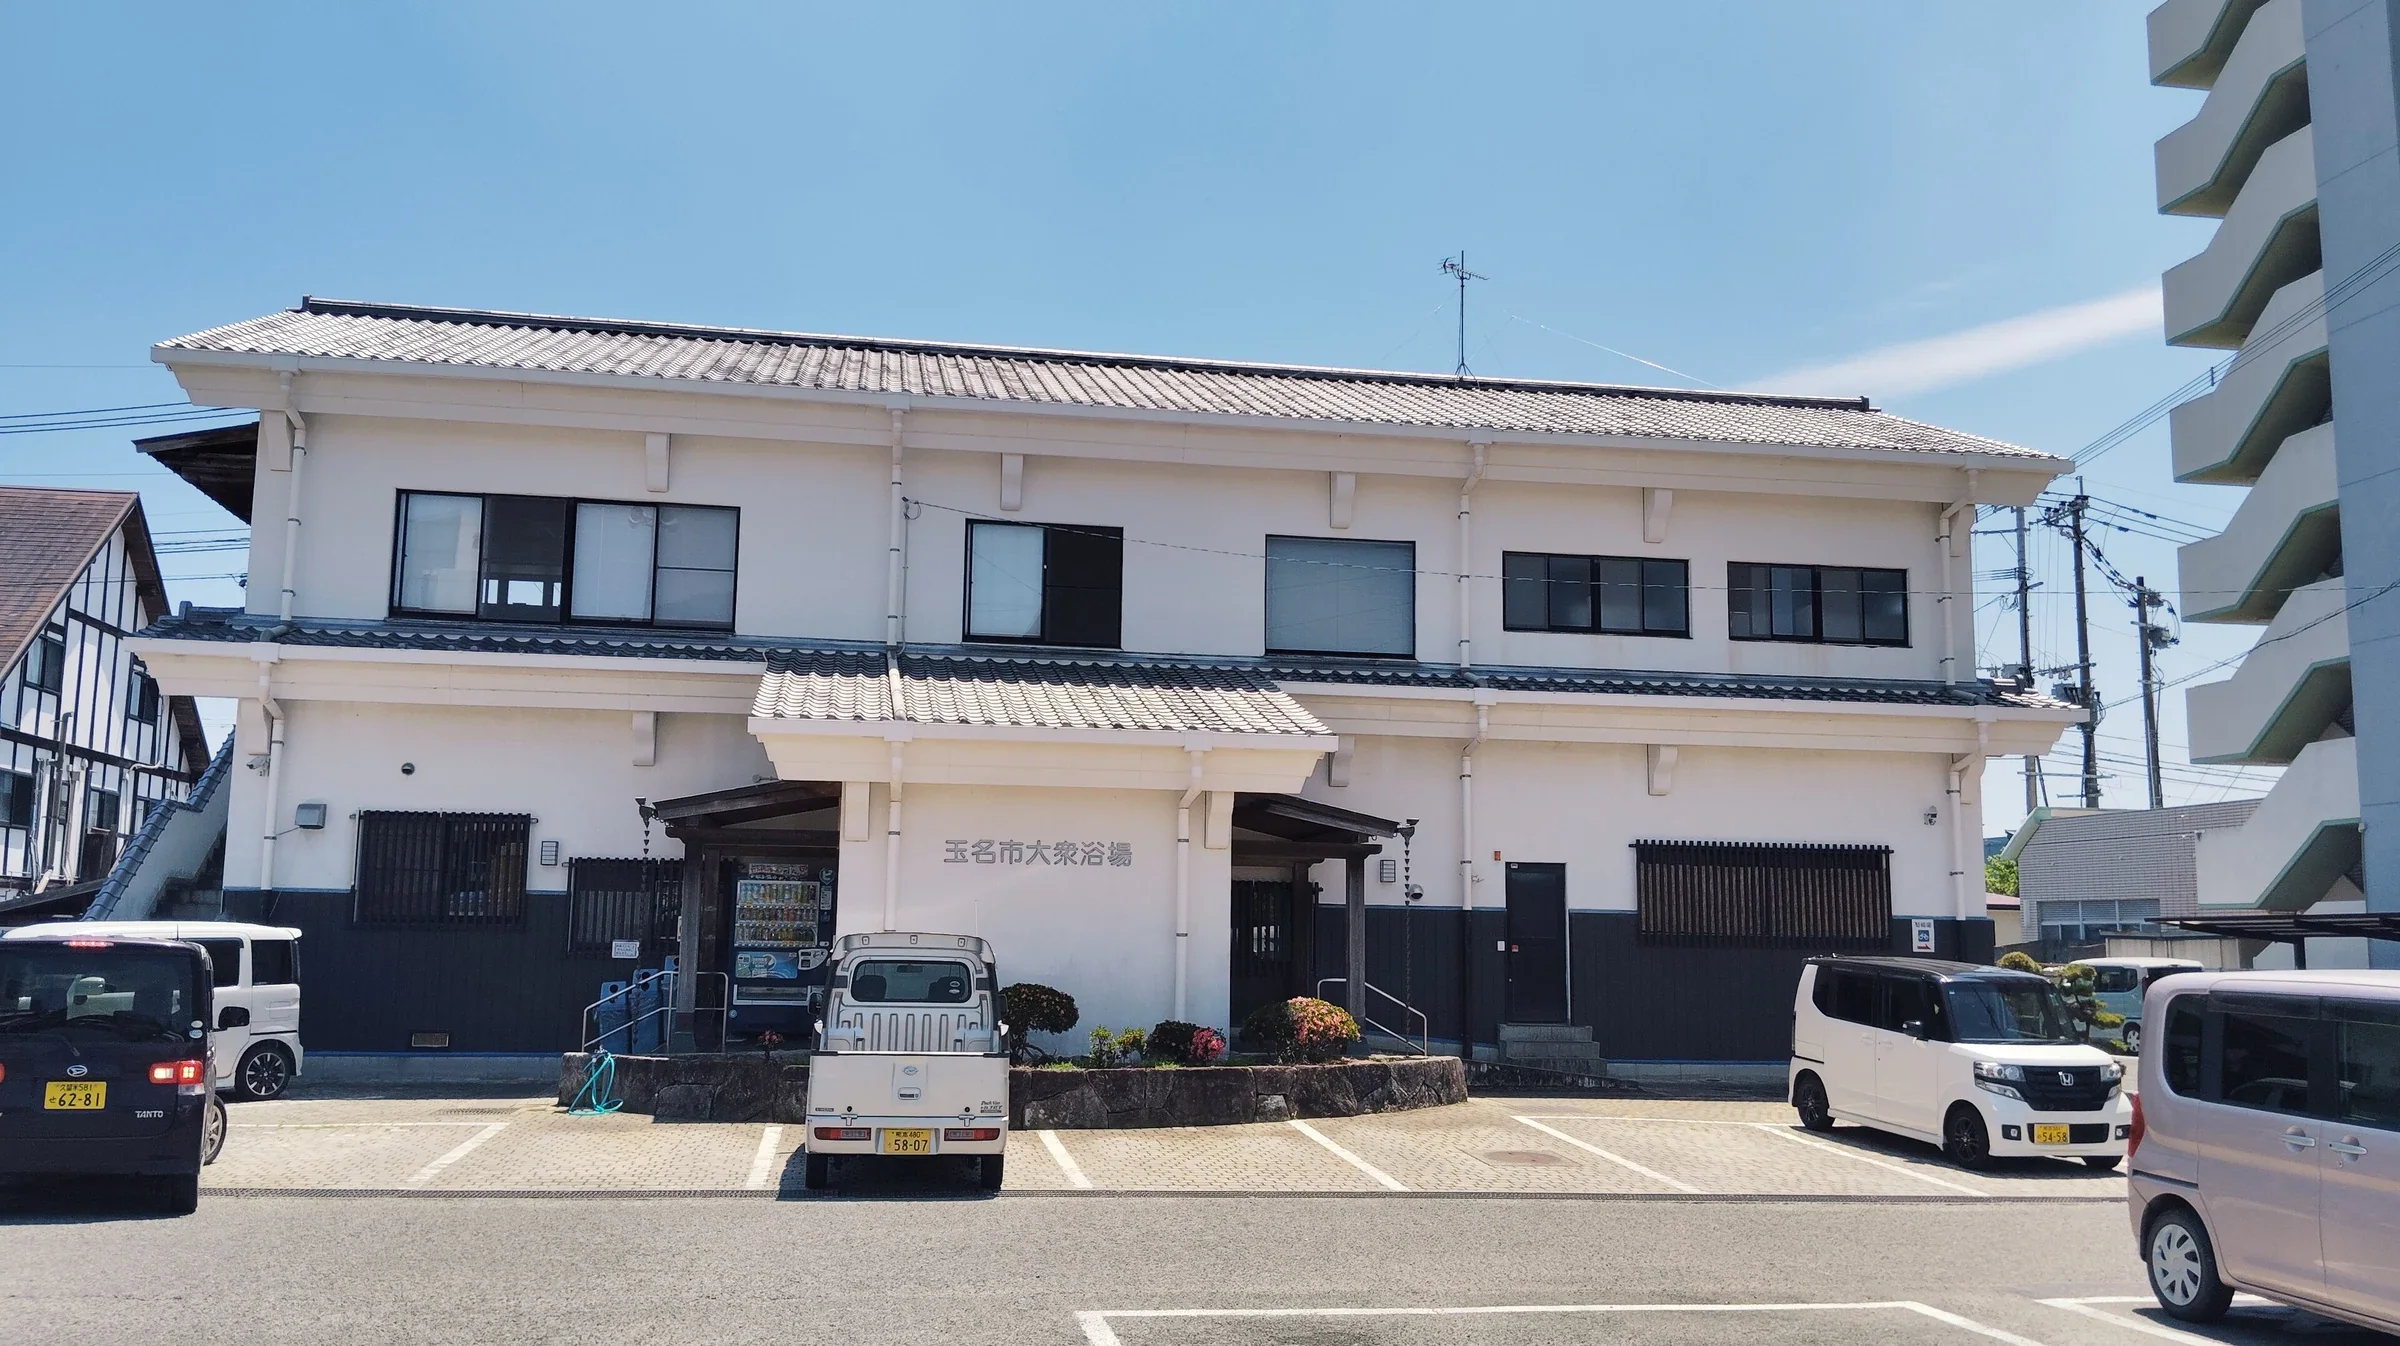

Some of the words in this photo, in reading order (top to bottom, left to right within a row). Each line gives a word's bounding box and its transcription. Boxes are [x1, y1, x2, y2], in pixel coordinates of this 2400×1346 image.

[943, 839, 1132, 867] 玉名市大衆浴場
[58, 1092, 100, 1107] 62-81
[134, 1110, 164, 1118] TANTO
[2042, 1131, 2068, 1142] 54-58
[894, 1139, 928, 1151] 58-07
